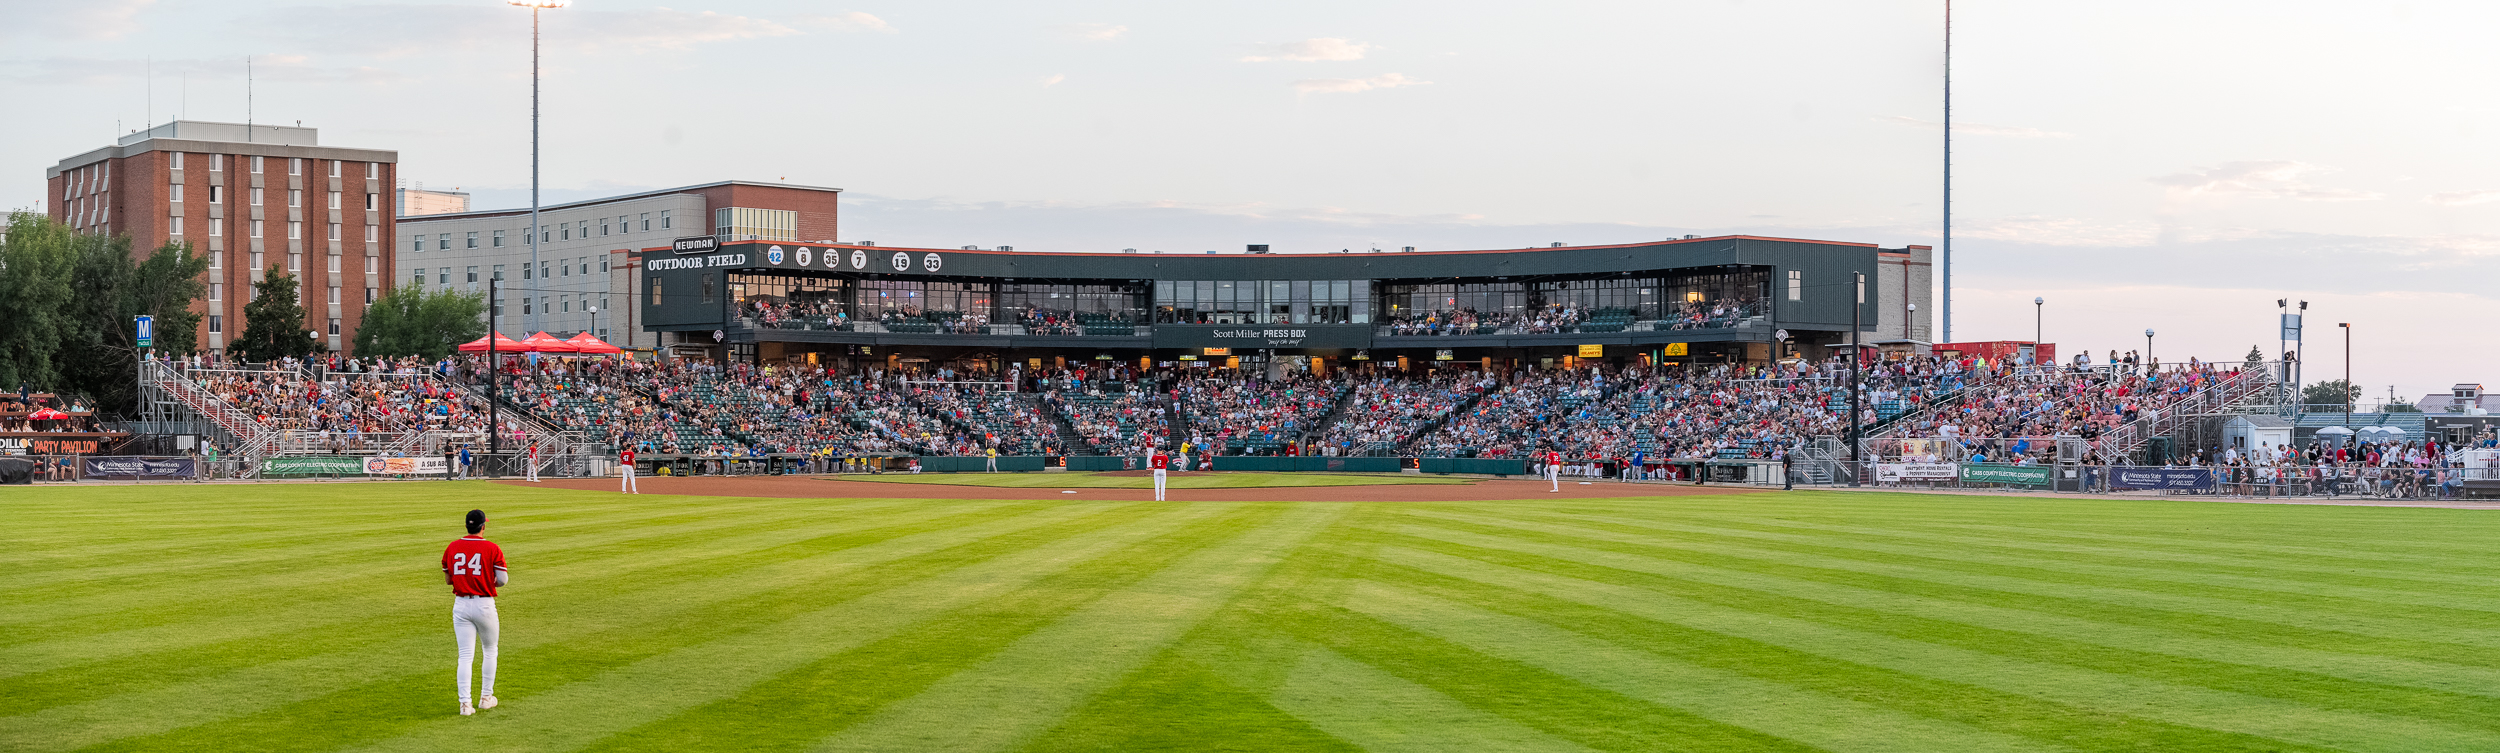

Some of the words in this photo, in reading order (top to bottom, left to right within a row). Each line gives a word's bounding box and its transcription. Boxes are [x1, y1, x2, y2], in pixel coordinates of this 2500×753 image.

[675, 239, 714, 250] NEWMAN
[648, 257, 703, 271] OUTDOOR
[707, 253, 746, 267] FIELD
[769, 252, 781, 262] 42
[801, 253, 807, 263] 8
[826, 255, 837, 265] 35
[856, 257, 862, 266] 7
[895, 259, 907, 268] 19
[926, 260, 939, 269] 33
[139, 320, 149, 338] M
[1213, 329, 1234, 338] Scott
[1235, 329, 1260, 338] Miller
[1263, 329, 1289, 338] PRESS
[1290, 329, 1306, 338] BOX
[34, 440, 59, 453] PARTY
[61, 440, 98, 453] PAVILION
[1060, 456, 1066, 467] 6
[1414, 458, 1420, 469] 5
[453, 552, 482, 576] 24
